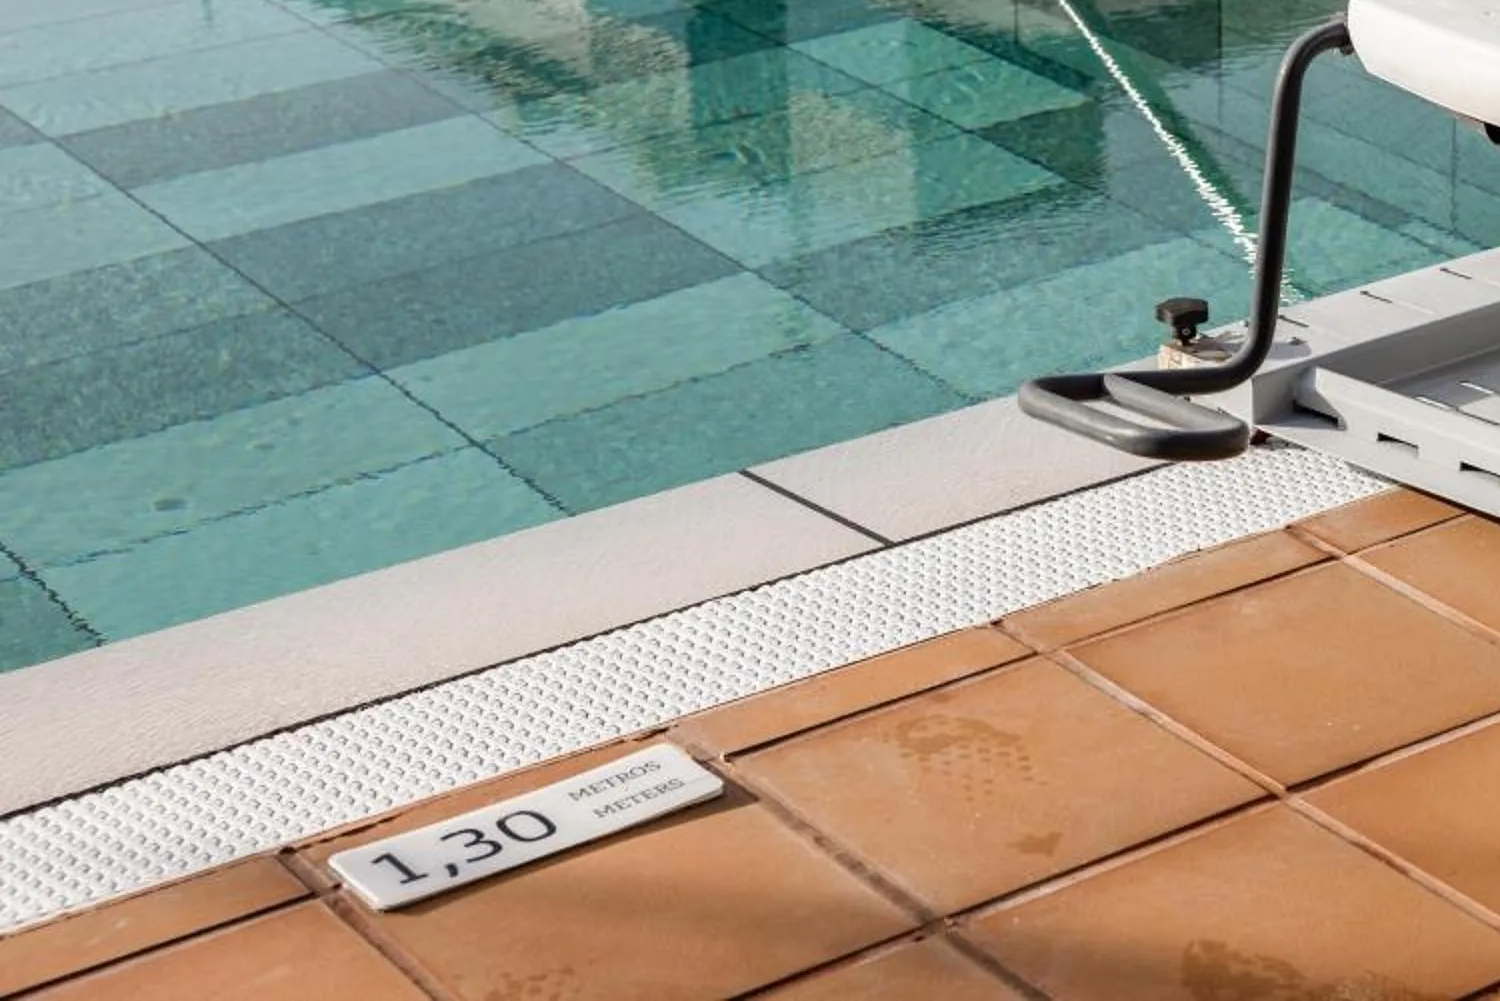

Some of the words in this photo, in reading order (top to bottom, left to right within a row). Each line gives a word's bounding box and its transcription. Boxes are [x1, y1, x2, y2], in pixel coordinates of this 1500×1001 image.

[568, 759, 662, 803] METROS
[592, 777, 686, 818] METERS
[371, 809, 557, 885] 1,30
